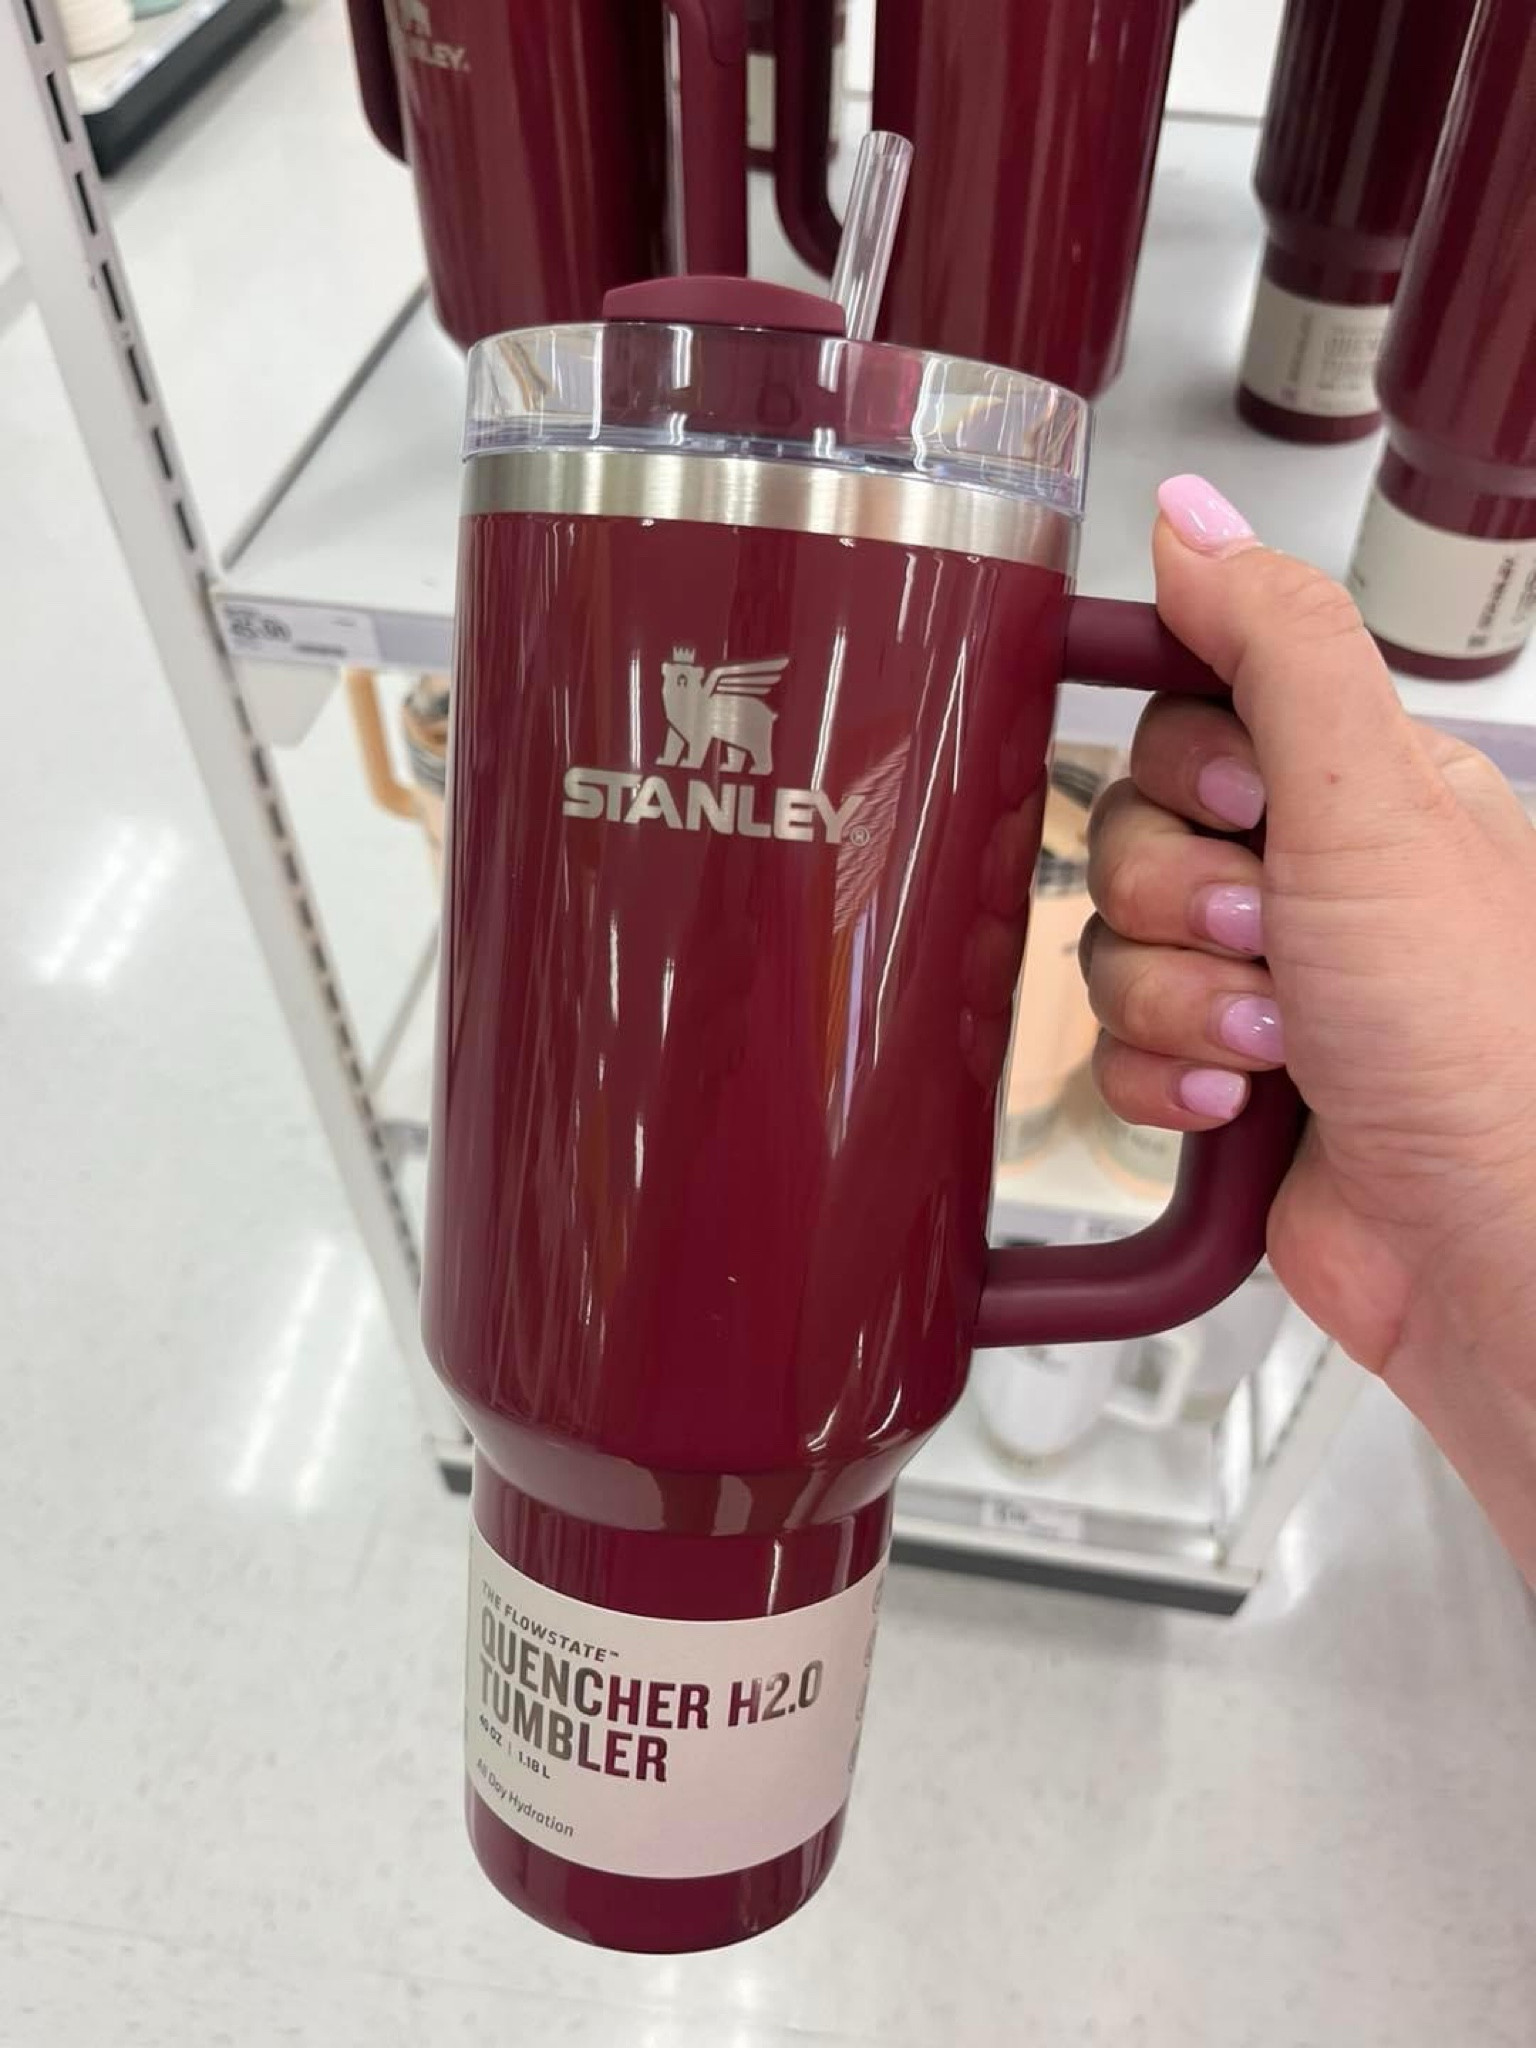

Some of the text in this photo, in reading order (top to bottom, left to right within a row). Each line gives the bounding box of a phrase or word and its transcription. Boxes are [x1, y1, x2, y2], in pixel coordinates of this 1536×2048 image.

[482, 1579, 501, 1610] THE
[481, 1605, 710, 1730] QUENCHER
[727, 1659, 823, 1727] H2.0
[480, 1653, 668, 1783] TUMBLER
[488, 1771, 507, 1799] Day
[508, 1791, 575, 1838] Hydration
[542, 1764, 550, 1779] L
